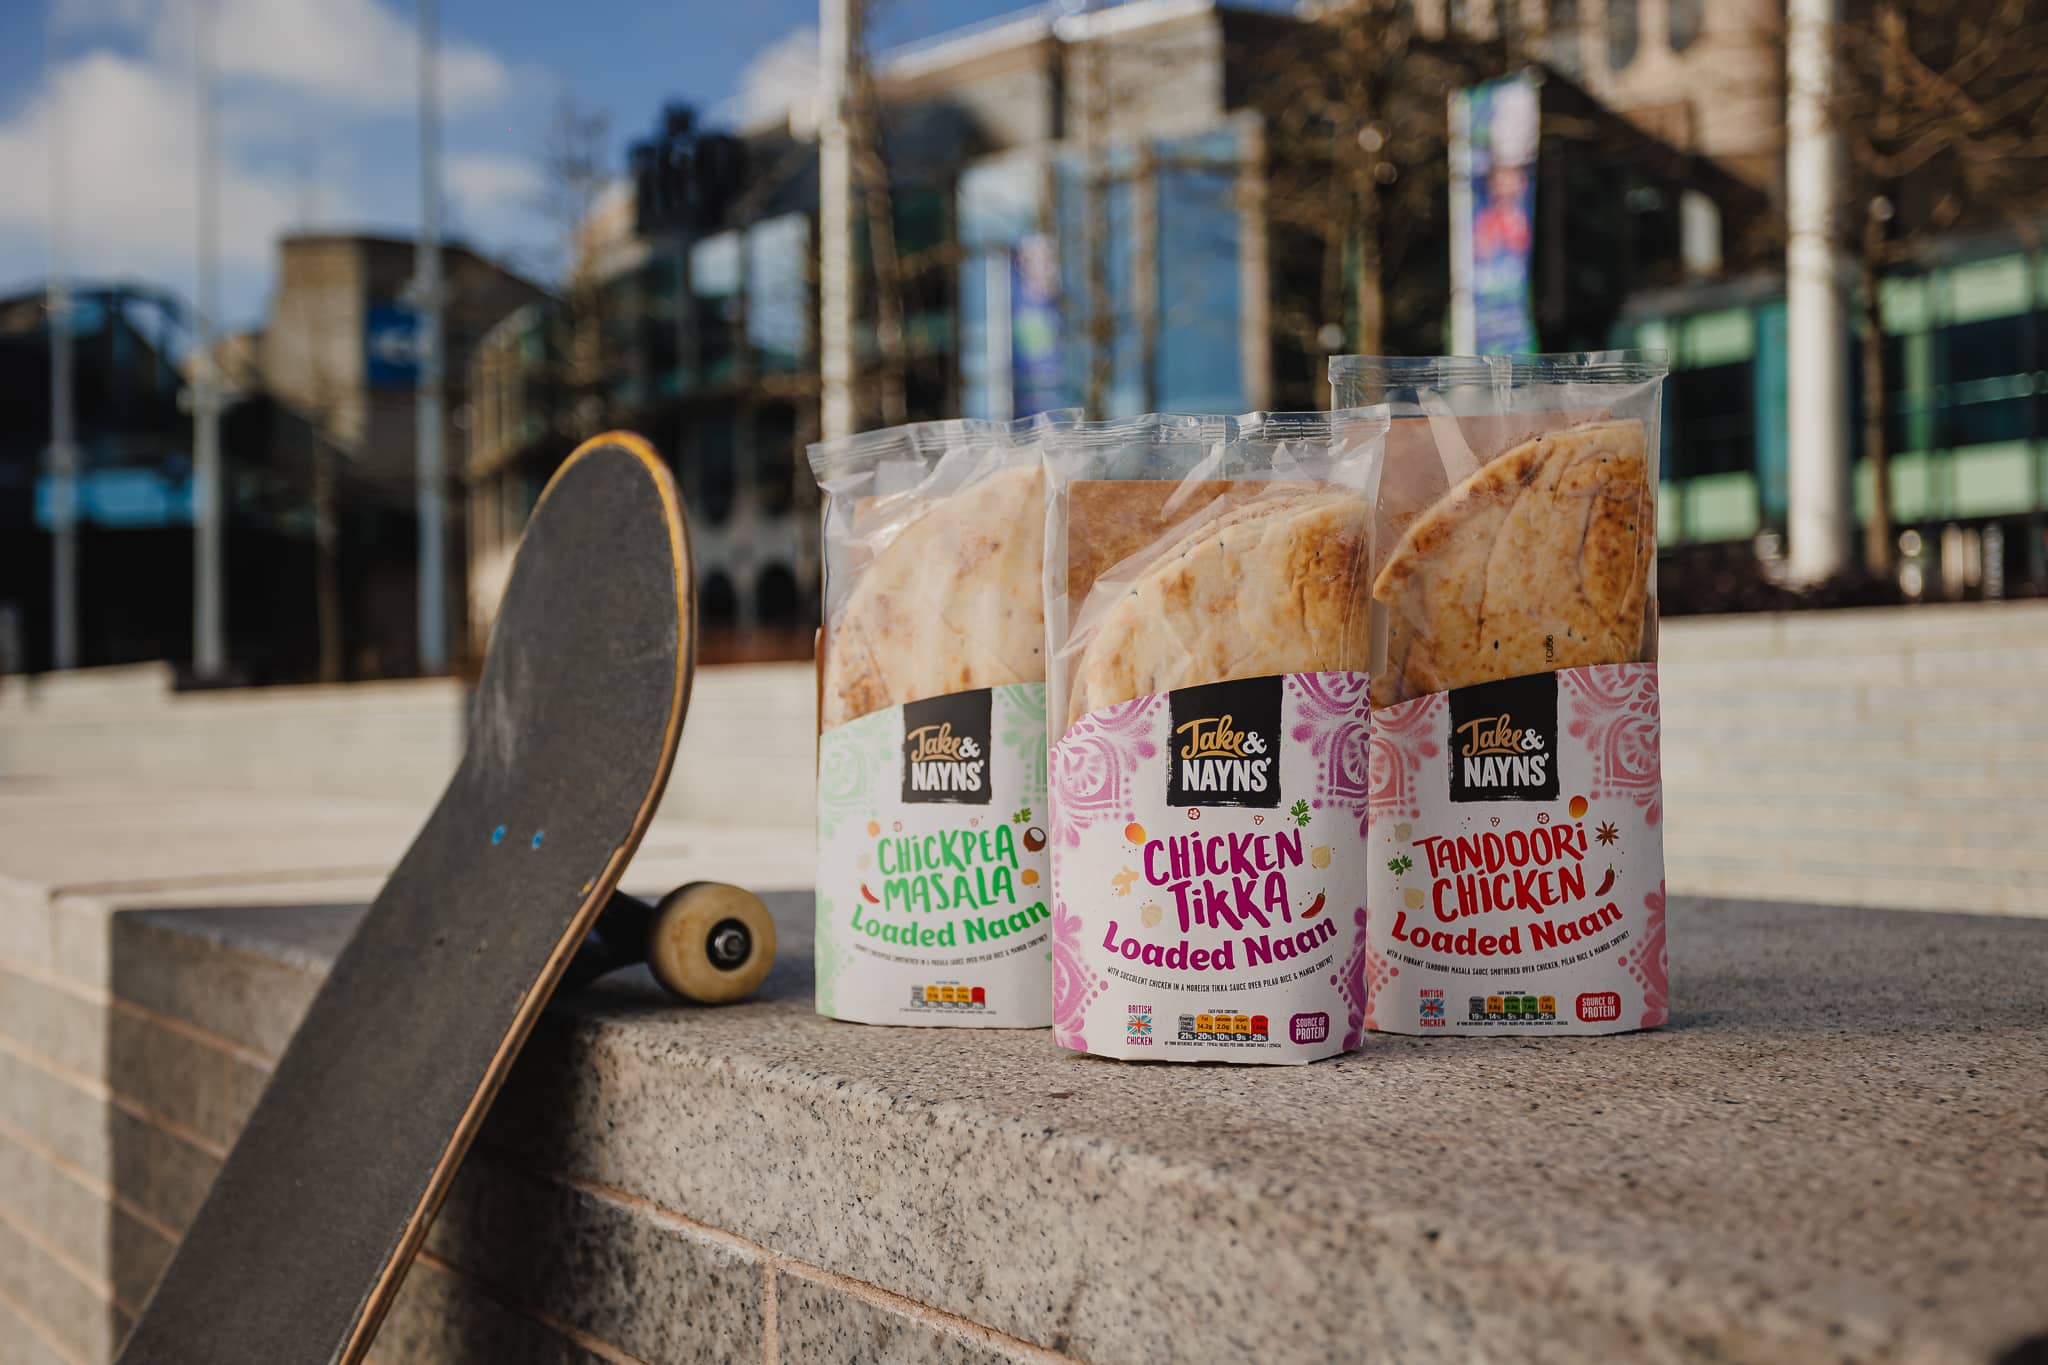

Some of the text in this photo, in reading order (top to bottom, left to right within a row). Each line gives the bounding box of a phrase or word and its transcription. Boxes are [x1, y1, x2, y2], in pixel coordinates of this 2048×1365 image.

[907, 722, 980, 762] Jake &
[1176, 714, 1268, 760] Jake &
[1456, 713, 1545, 757] Jake &
[883, 865, 1016, 913] MASALA
[850, 902, 1050, 948] Loaded Naan
[1391, 901, 1624, 956] Loaded Naan
[1102, 918, 1338, 971] Loaded Naan
[1386, 949, 1398, 959] WITH
[1403, 956, 1424, 968] VIBRANT
[1425, 961, 1450, 972] TANDOORI
[1450, 967, 1471, 975] MASALA
[1472, 968, 1488, 976] SAUCE
[1490, 966, 1520, 976] SMOTHERED
[1522, 964, 1535, 974] OVER
[1561, 956, 1576, 966] PILAU
[1576, 952, 1588, 961] RICE
[1594, 942, 1610, 955] MANGO
[1610, 930, 1630, 946] CHUTNEY
[1108, 966, 1120, 976] WITH
[1120, 971, 1148, 986] SUCCULENT
[1149, 979, 1172, 990] CHICKEN
[1173, 983, 1180, 991] IN
[1186, 984, 1210, 992] MOREISH
[1212, 984, 1228, 992] TIKKA
[1229, 982, 1246, 992] SAUCE
[1248, 980, 1262, 990] OVER
[1263, 978, 1279, 987] PILAU
[1280, 975, 1292, 983] RICE
[1293, 972, 1298, 980] &
[1299, 965, 1315, 978] MANGO
[1315, 955, 1334, 970] CHUTNEY
[1420, 989, 1444, 998] BRITISH
[1582, 996, 1615, 1006] SOURCE OF
[1128, 1004, 1152, 1014] BRITISH
[1582, 1005, 1616, 1019] PROTEIN
[1296, 1016, 1325, 1028] SOURCE OF
[1296, 1027, 1325, 1040] PROTEIN
[1419, 1018, 1446, 1028] CHICKEN
[1126, 1036, 1153, 1046] CHICKEN
[1180, 1032, 1193, 1040] 21%
